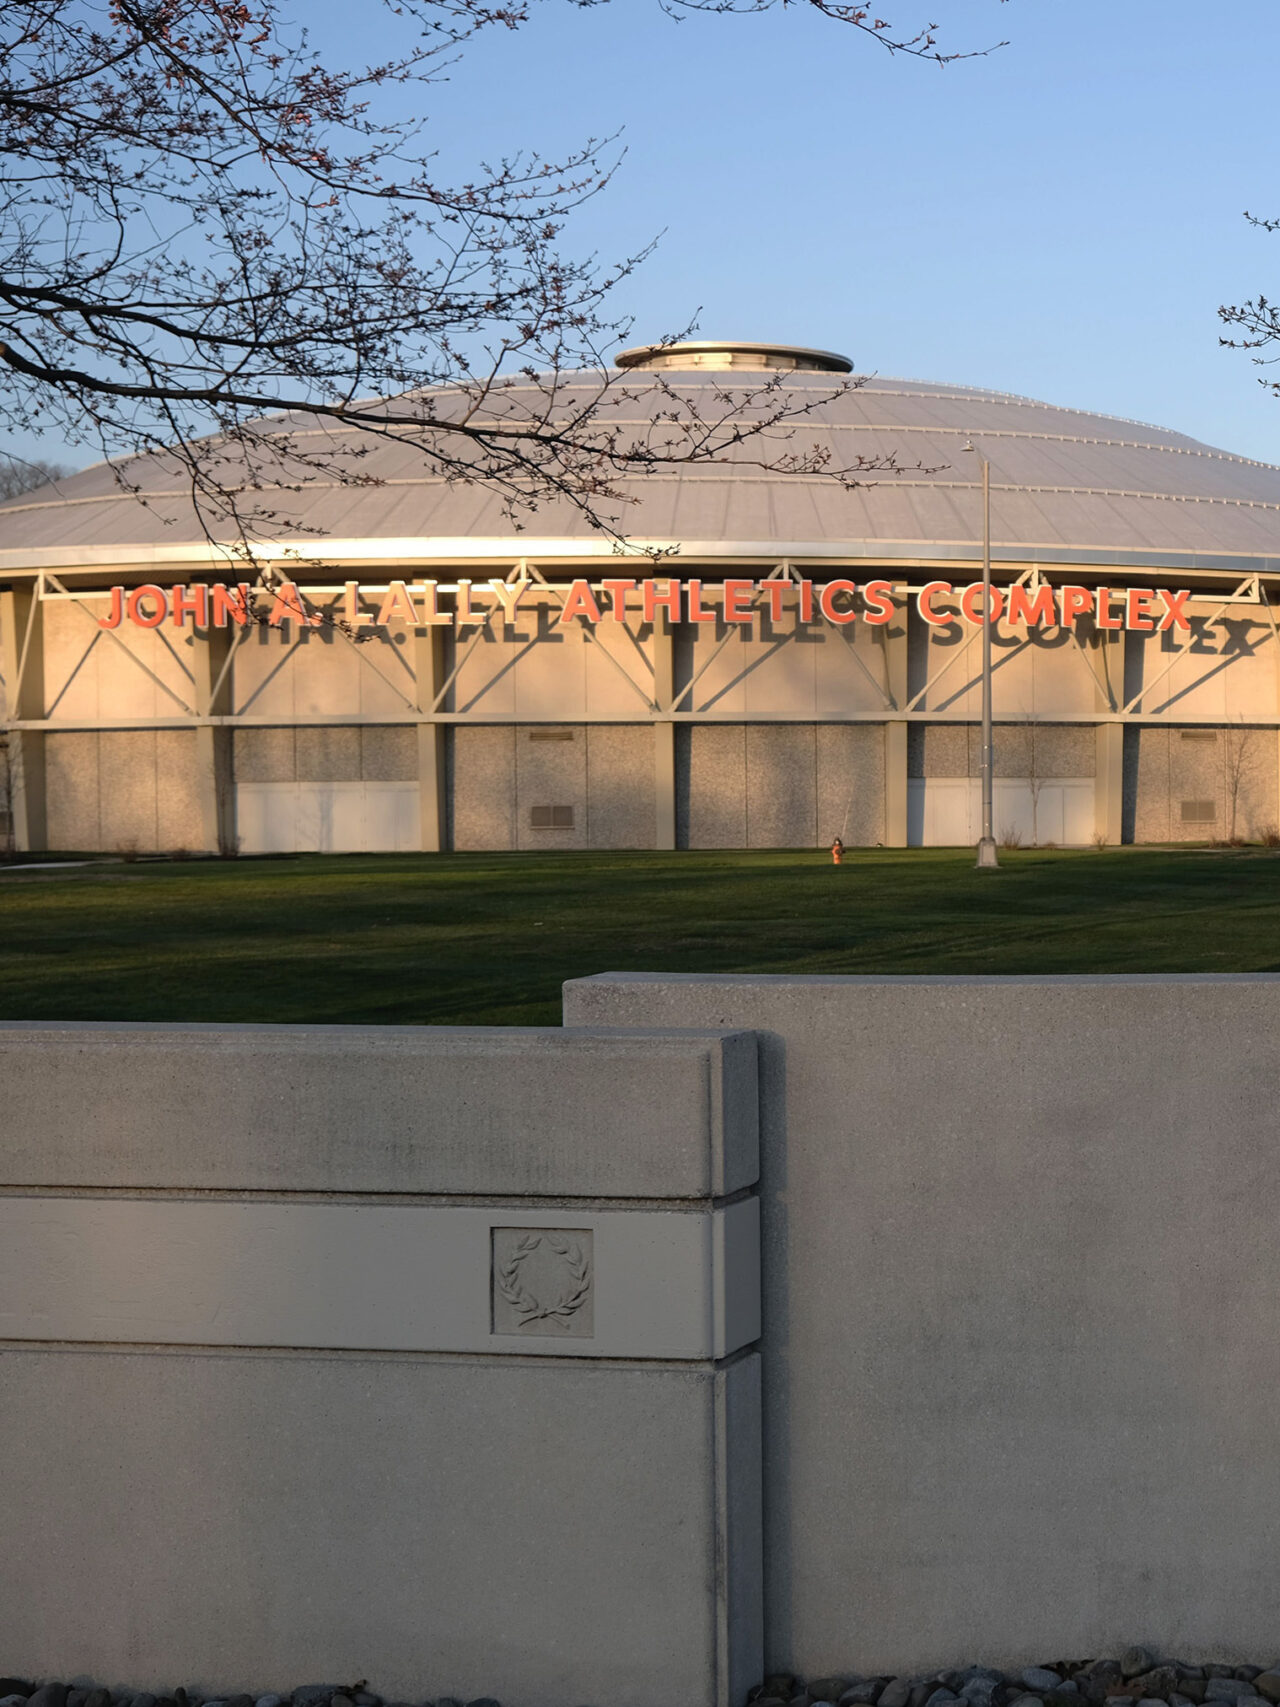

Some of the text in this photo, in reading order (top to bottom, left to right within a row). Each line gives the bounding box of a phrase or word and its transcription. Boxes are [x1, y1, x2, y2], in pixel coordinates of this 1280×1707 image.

[98, 583, 250, 629] JOHN
[344, 580, 532, 626] LALLY
[560, 579, 897, 625] ATHLETICS
[916, 581, 1192, 631] COMPLEX
